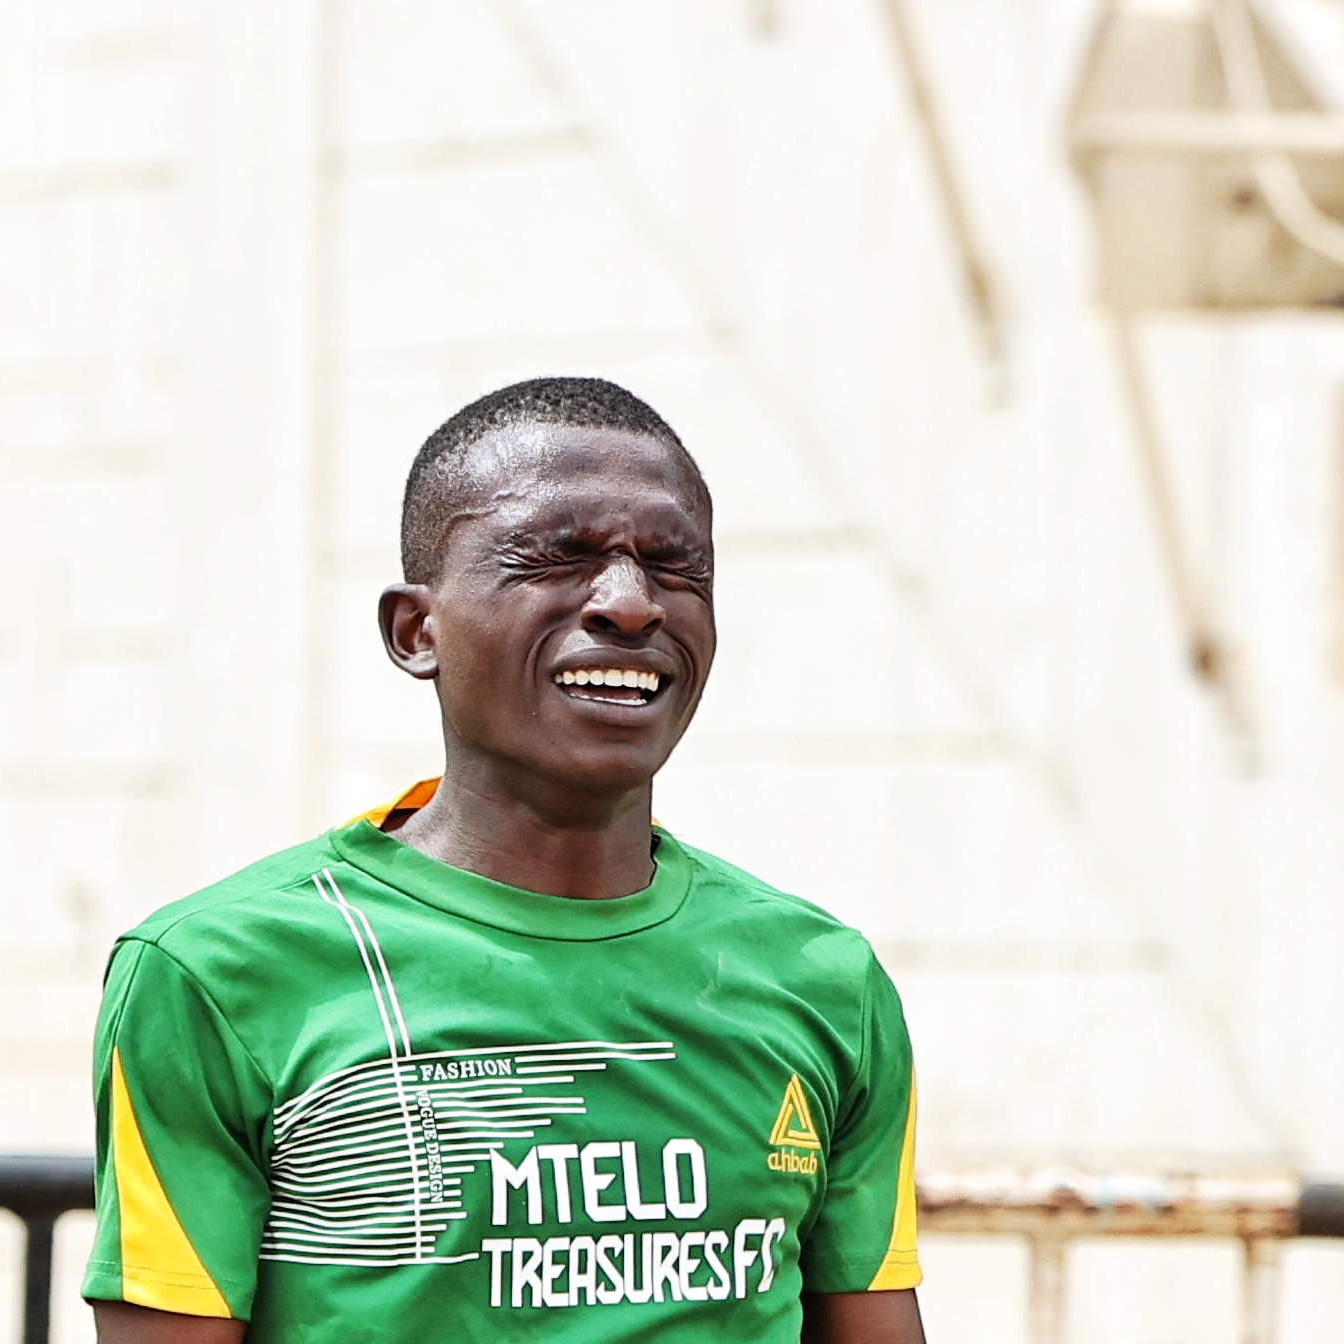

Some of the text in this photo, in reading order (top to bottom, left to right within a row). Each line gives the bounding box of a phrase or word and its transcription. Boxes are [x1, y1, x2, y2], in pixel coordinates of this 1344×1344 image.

[420, 1059, 512, 1081] FASHION
[416, 1090, 444, 1203] VOGUE DESIGN
[490, 1138, 707, 1225] MTELO
[767, 1149, 818, 1174] ahbab
[482, 1230, 731, 1308] TREASURES
